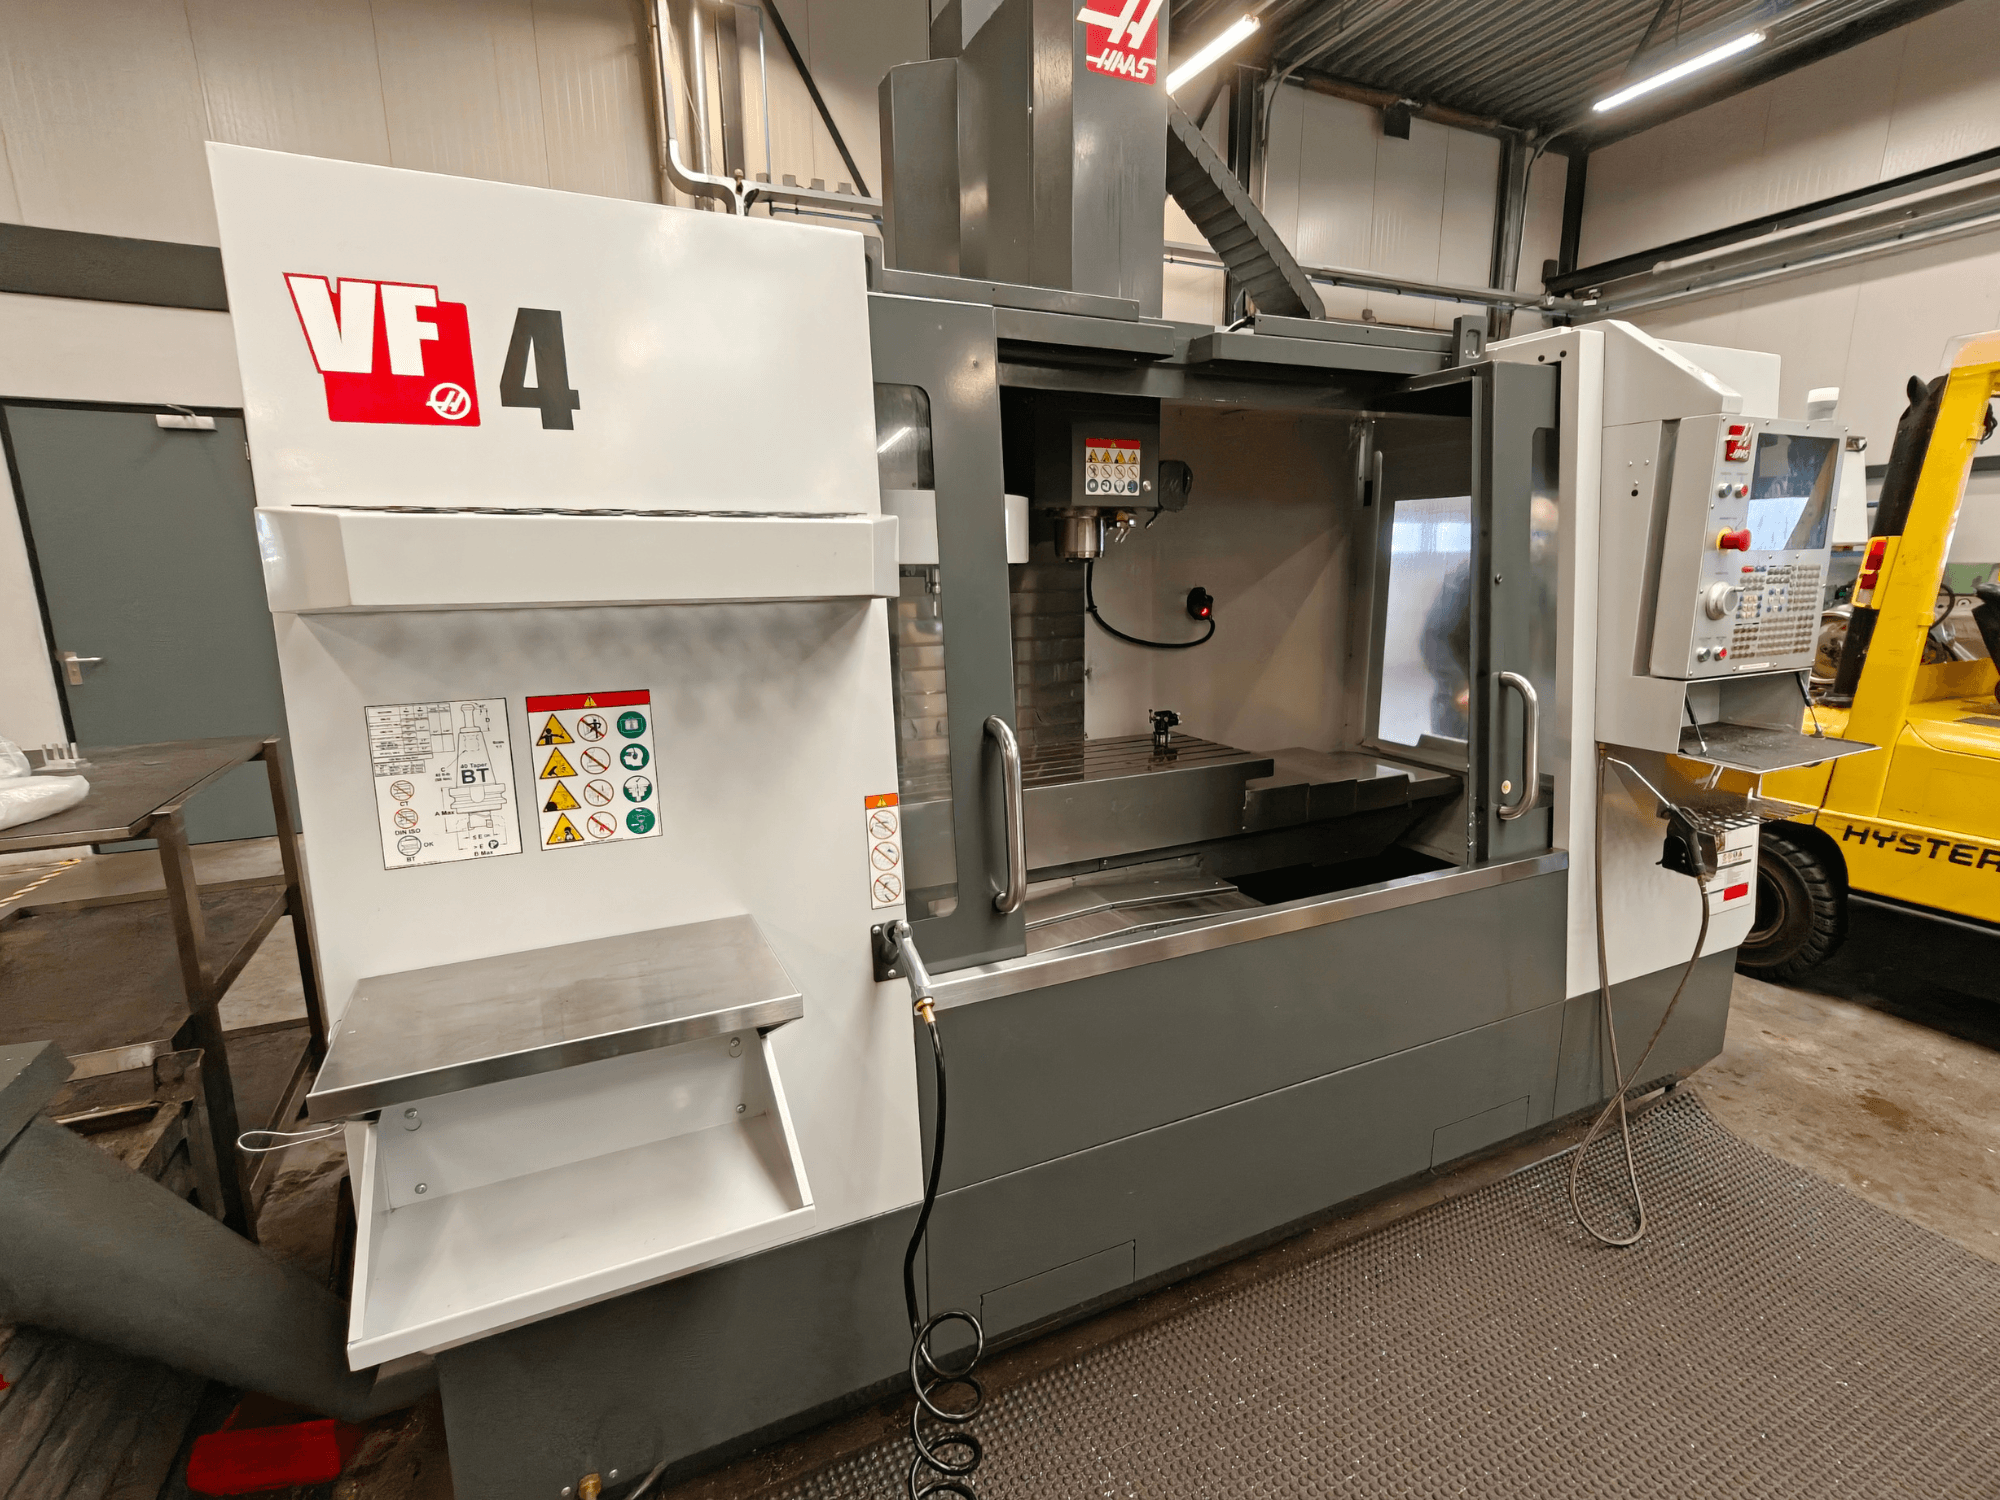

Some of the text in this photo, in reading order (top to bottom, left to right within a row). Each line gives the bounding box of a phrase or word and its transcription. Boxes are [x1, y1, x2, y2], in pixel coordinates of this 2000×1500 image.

[1086, 47, 1156, 79] HAAS
[285, 274, 580, 430] VF 4
[461, 767, 489, 784] BT
[1842, 824, 2000, 873] HYSTER
